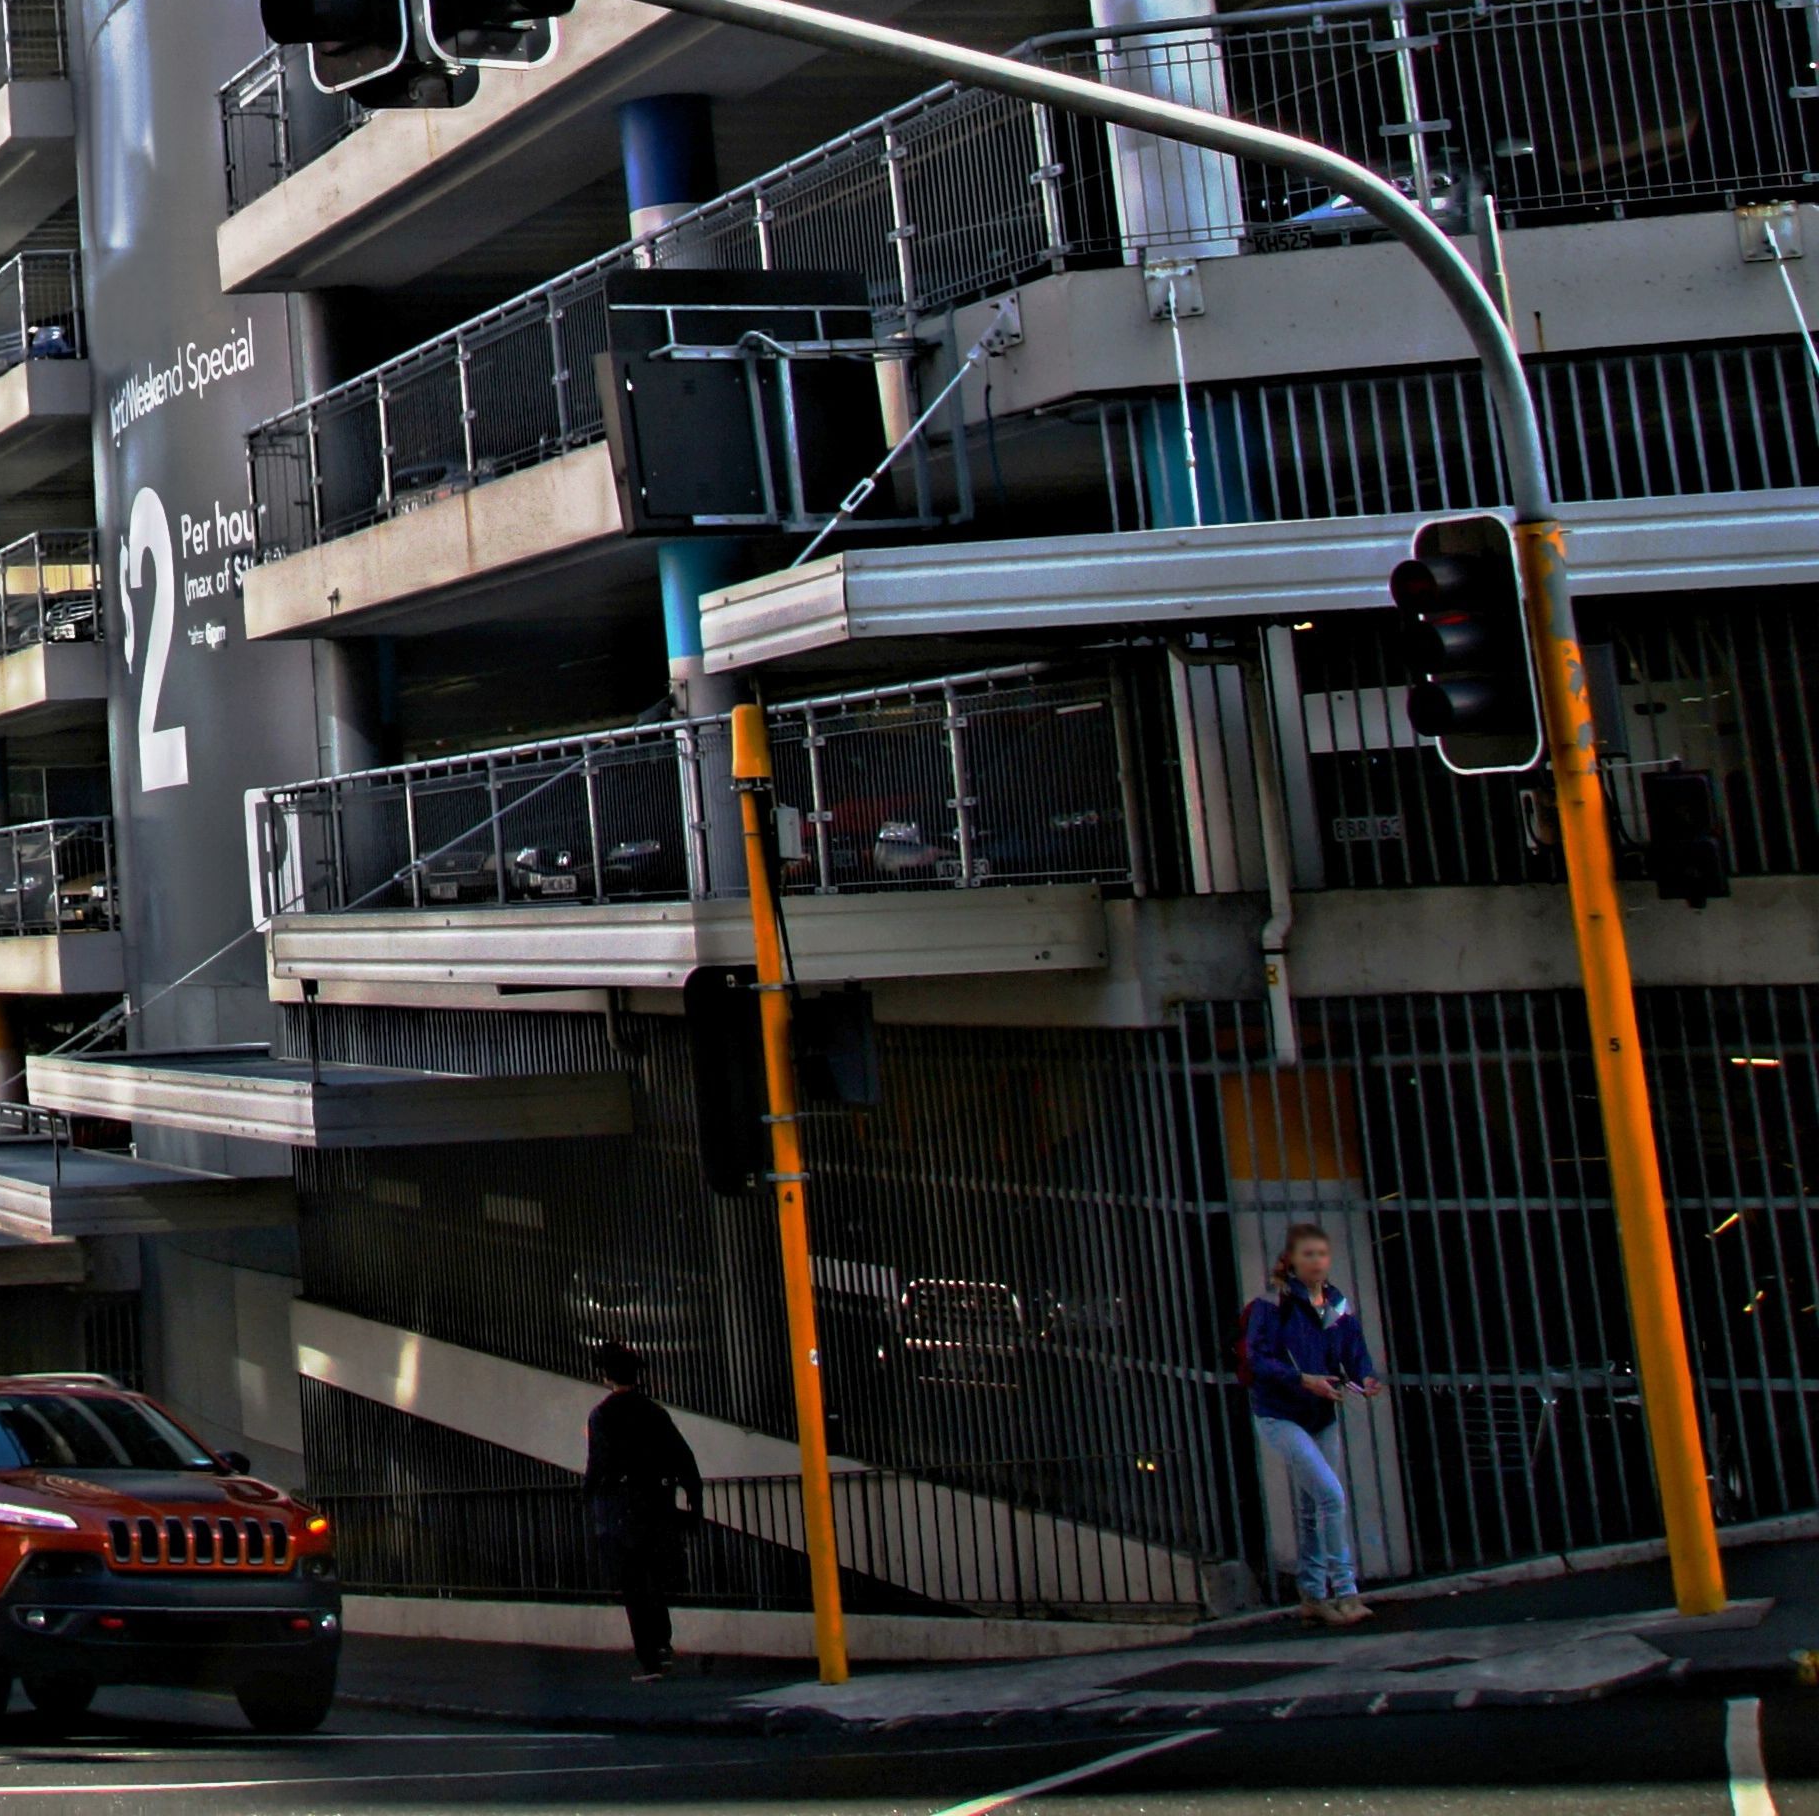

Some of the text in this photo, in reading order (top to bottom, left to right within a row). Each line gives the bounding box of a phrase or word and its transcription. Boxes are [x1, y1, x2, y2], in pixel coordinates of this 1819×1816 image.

[1246, 230, 1311, 255] KH525
[186, 316, 255, 399] Special
[181, 513, 211, 559] Per
[184, 571, 214, 607] (max
[216, 557, 231, 594] of
[1609, 1036, 1620, 1052] 5
[784, 1190, 794, 1204] 4
